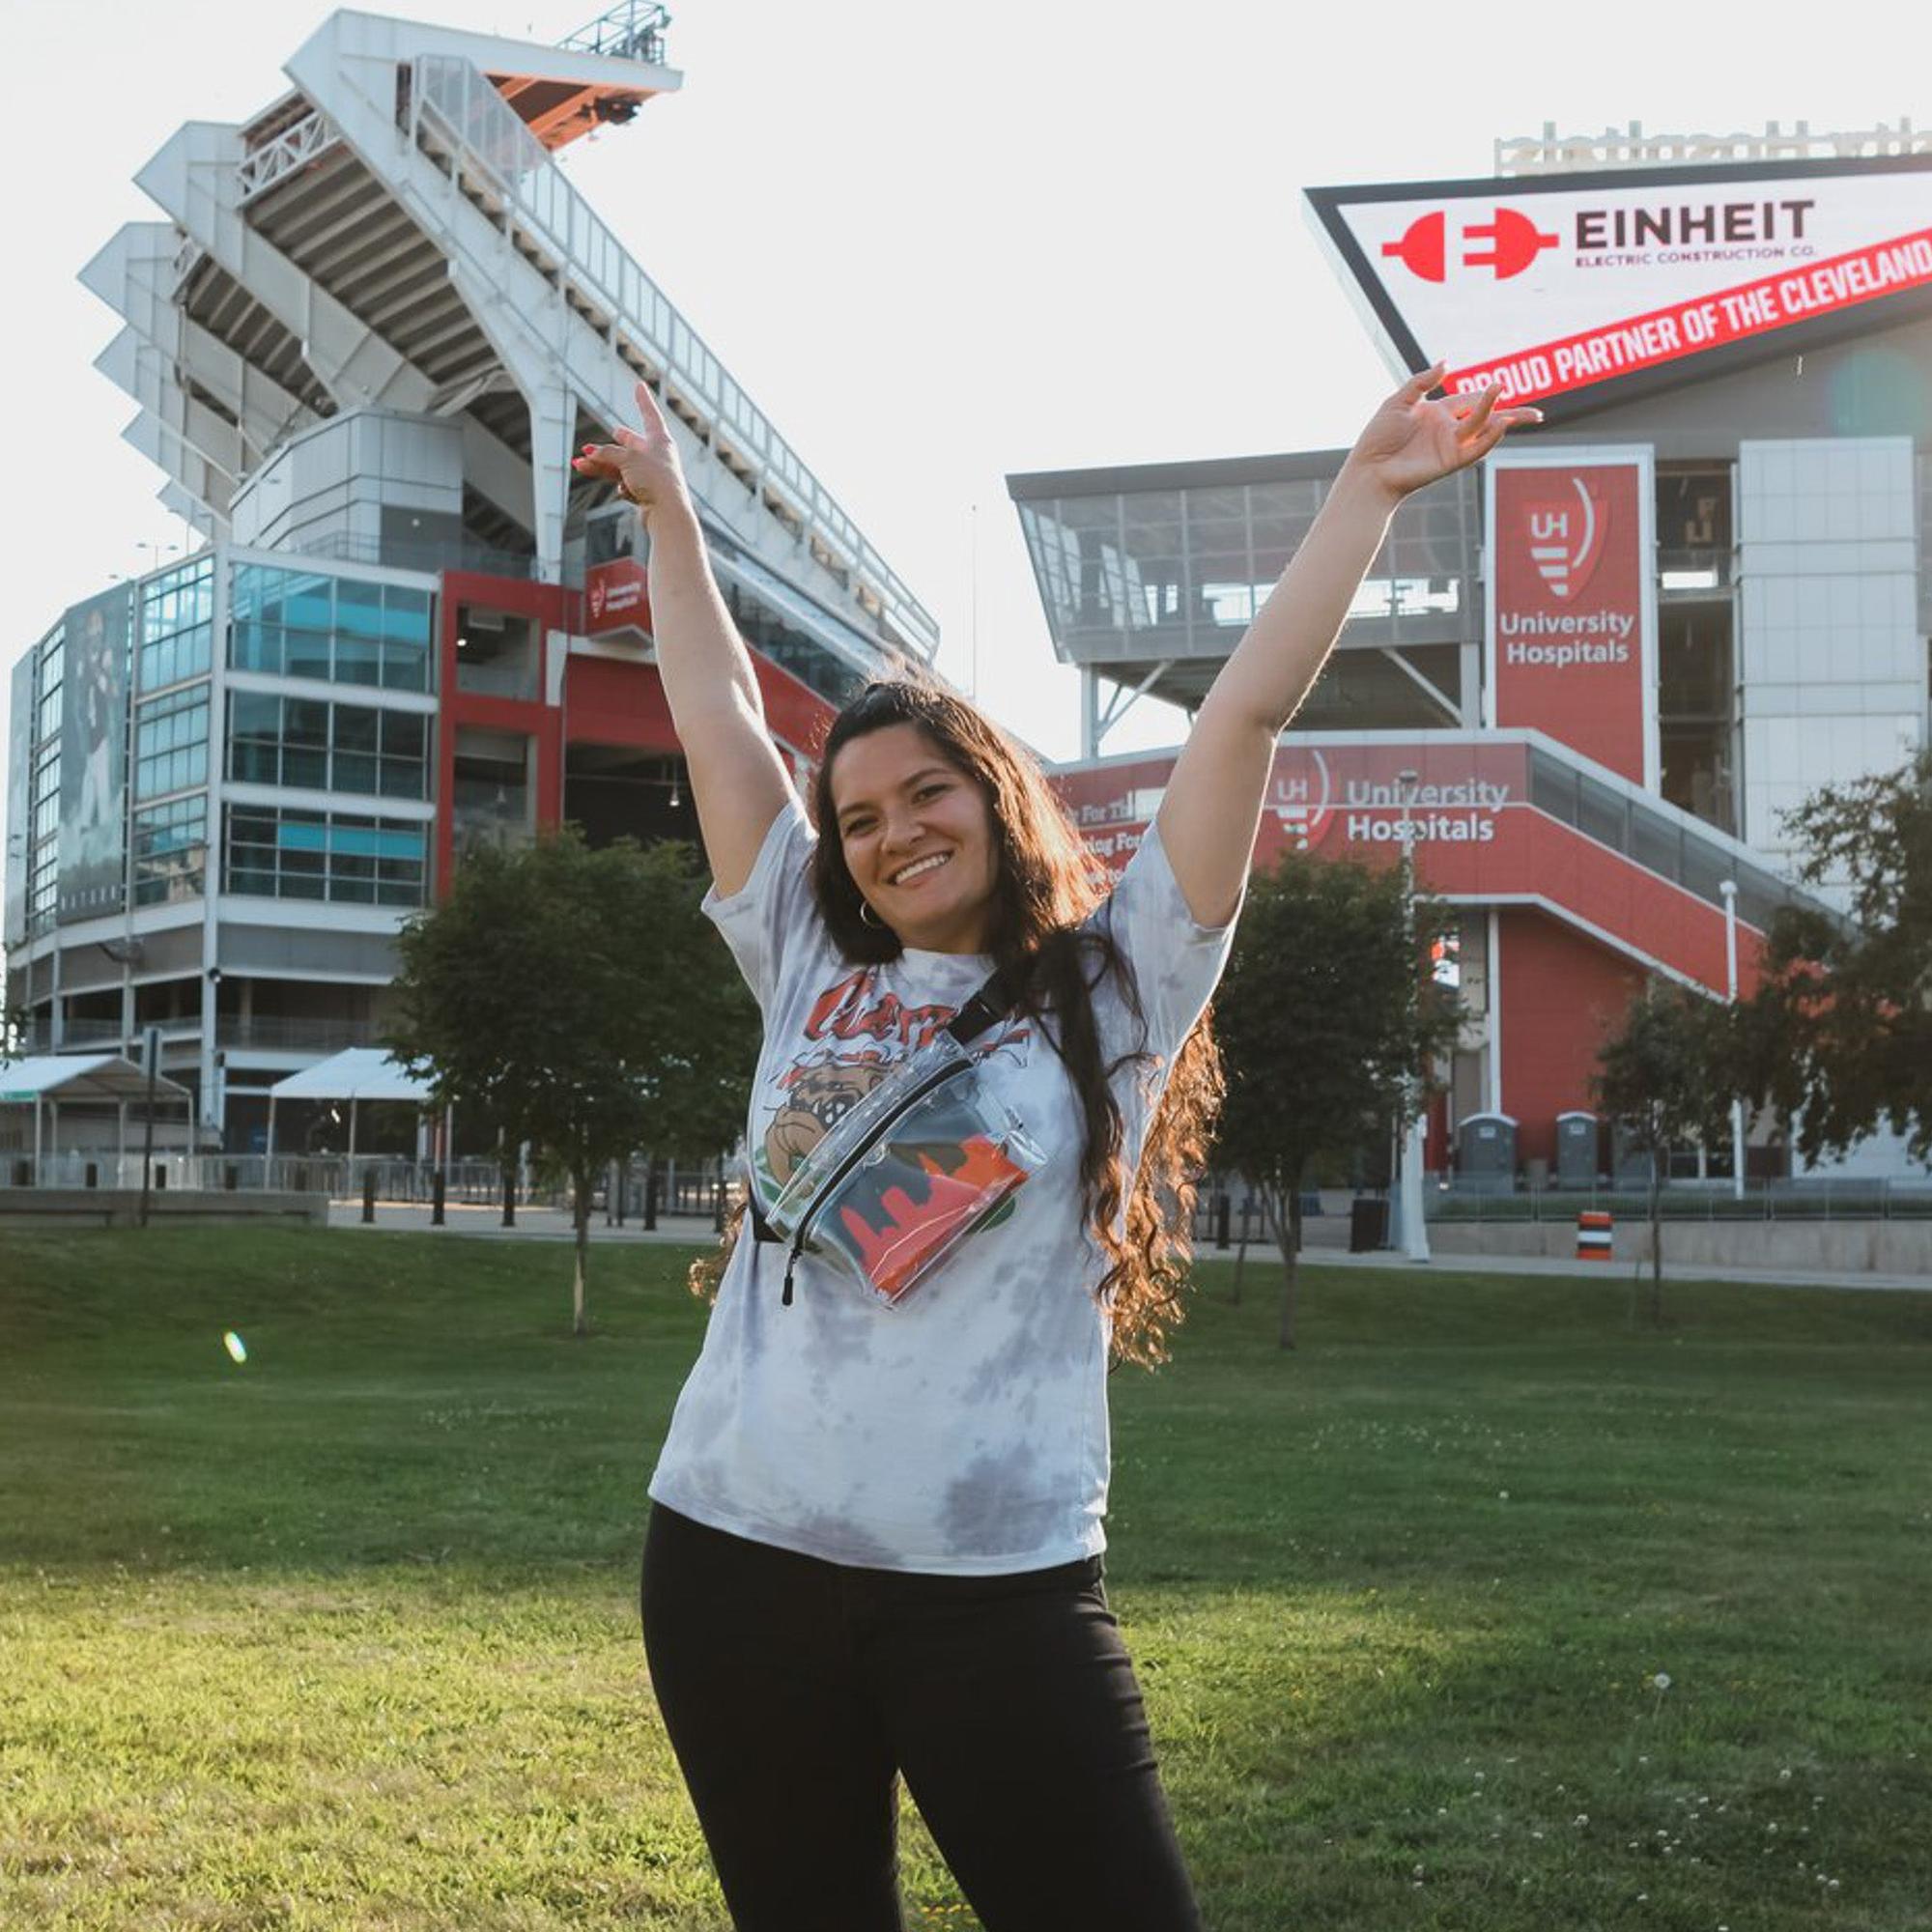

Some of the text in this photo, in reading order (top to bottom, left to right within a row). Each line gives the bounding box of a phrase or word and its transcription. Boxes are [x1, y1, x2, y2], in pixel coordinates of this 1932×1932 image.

[1577, 200, 1814, 249] EINHEIT
[1577, 244, 1817, 268] ELECTRIC CONSTRUCTION CO.
[1553, 317, 1682, 383] PARTNER
[1682, 302, 1719, 344] OF
[1719, 285, 1779, 333] THE
[1778, 240, 1932, 315] CLEVELAND
[1531, 513, 1568, 538] UH
[1500, 611, 1634, 638] University
[1507, 641, 1629, 668] Hospitals
[1277, 779, 1308, 801] UH
